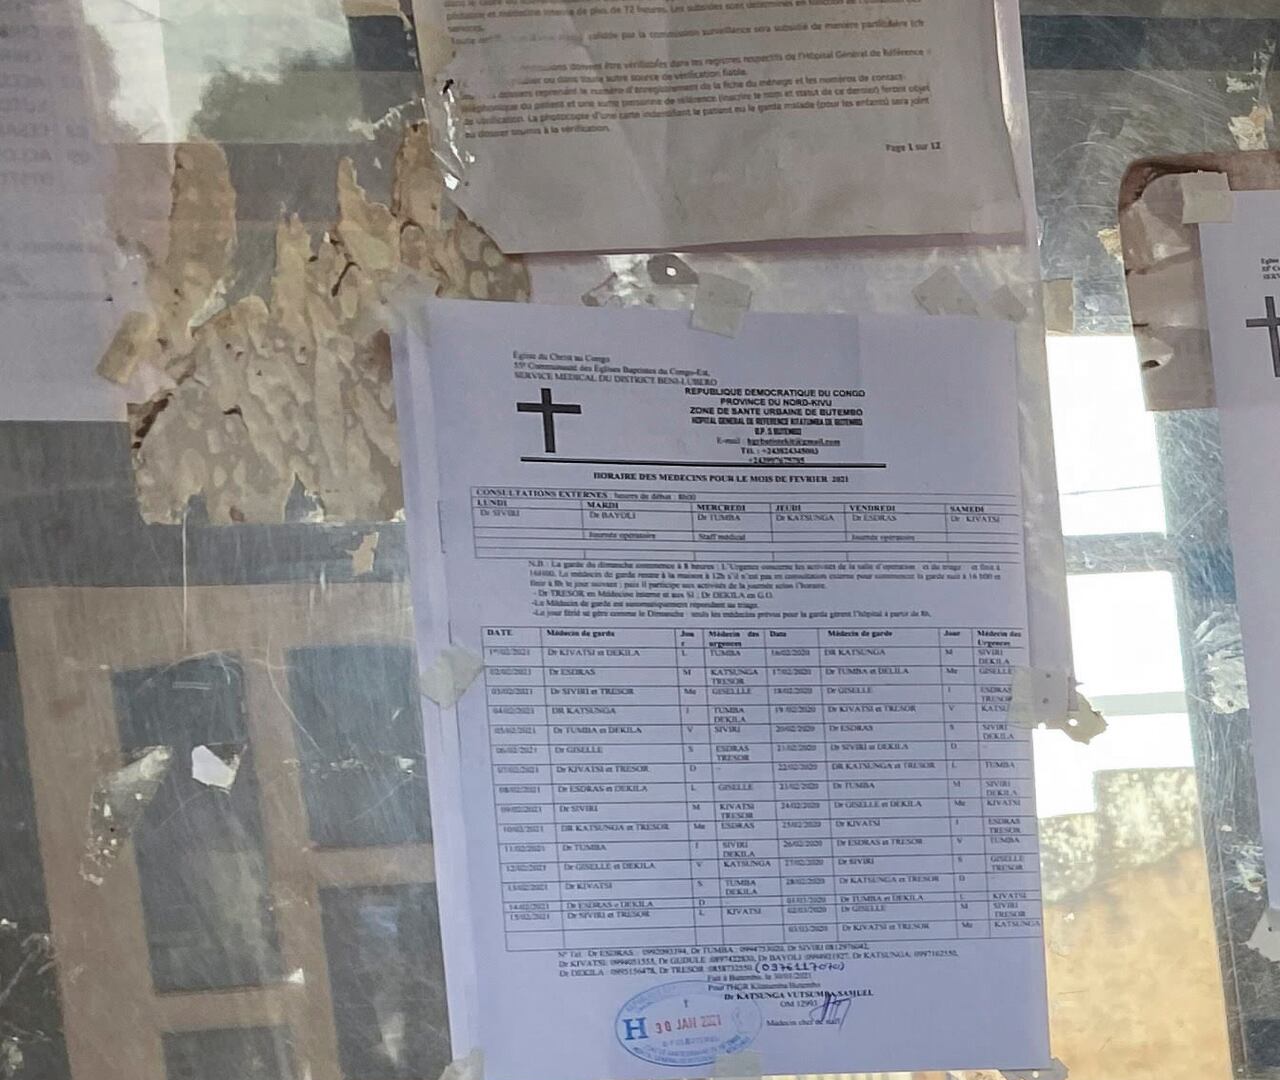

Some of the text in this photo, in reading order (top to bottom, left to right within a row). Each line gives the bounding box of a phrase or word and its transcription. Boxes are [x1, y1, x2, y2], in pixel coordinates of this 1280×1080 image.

[685, 388, 742, 396] REPUBLIQUE
[744, 389, 815, 397] DEMOCRATIQUE
[690, 407, 714, 415] ZONE
[594, 472, 636, 480] HORAIRE
[659, 474, 708, 482] MEDECINS
[709, 475, 735, 483] POUR
[623, 1017, 649, 1041] H
